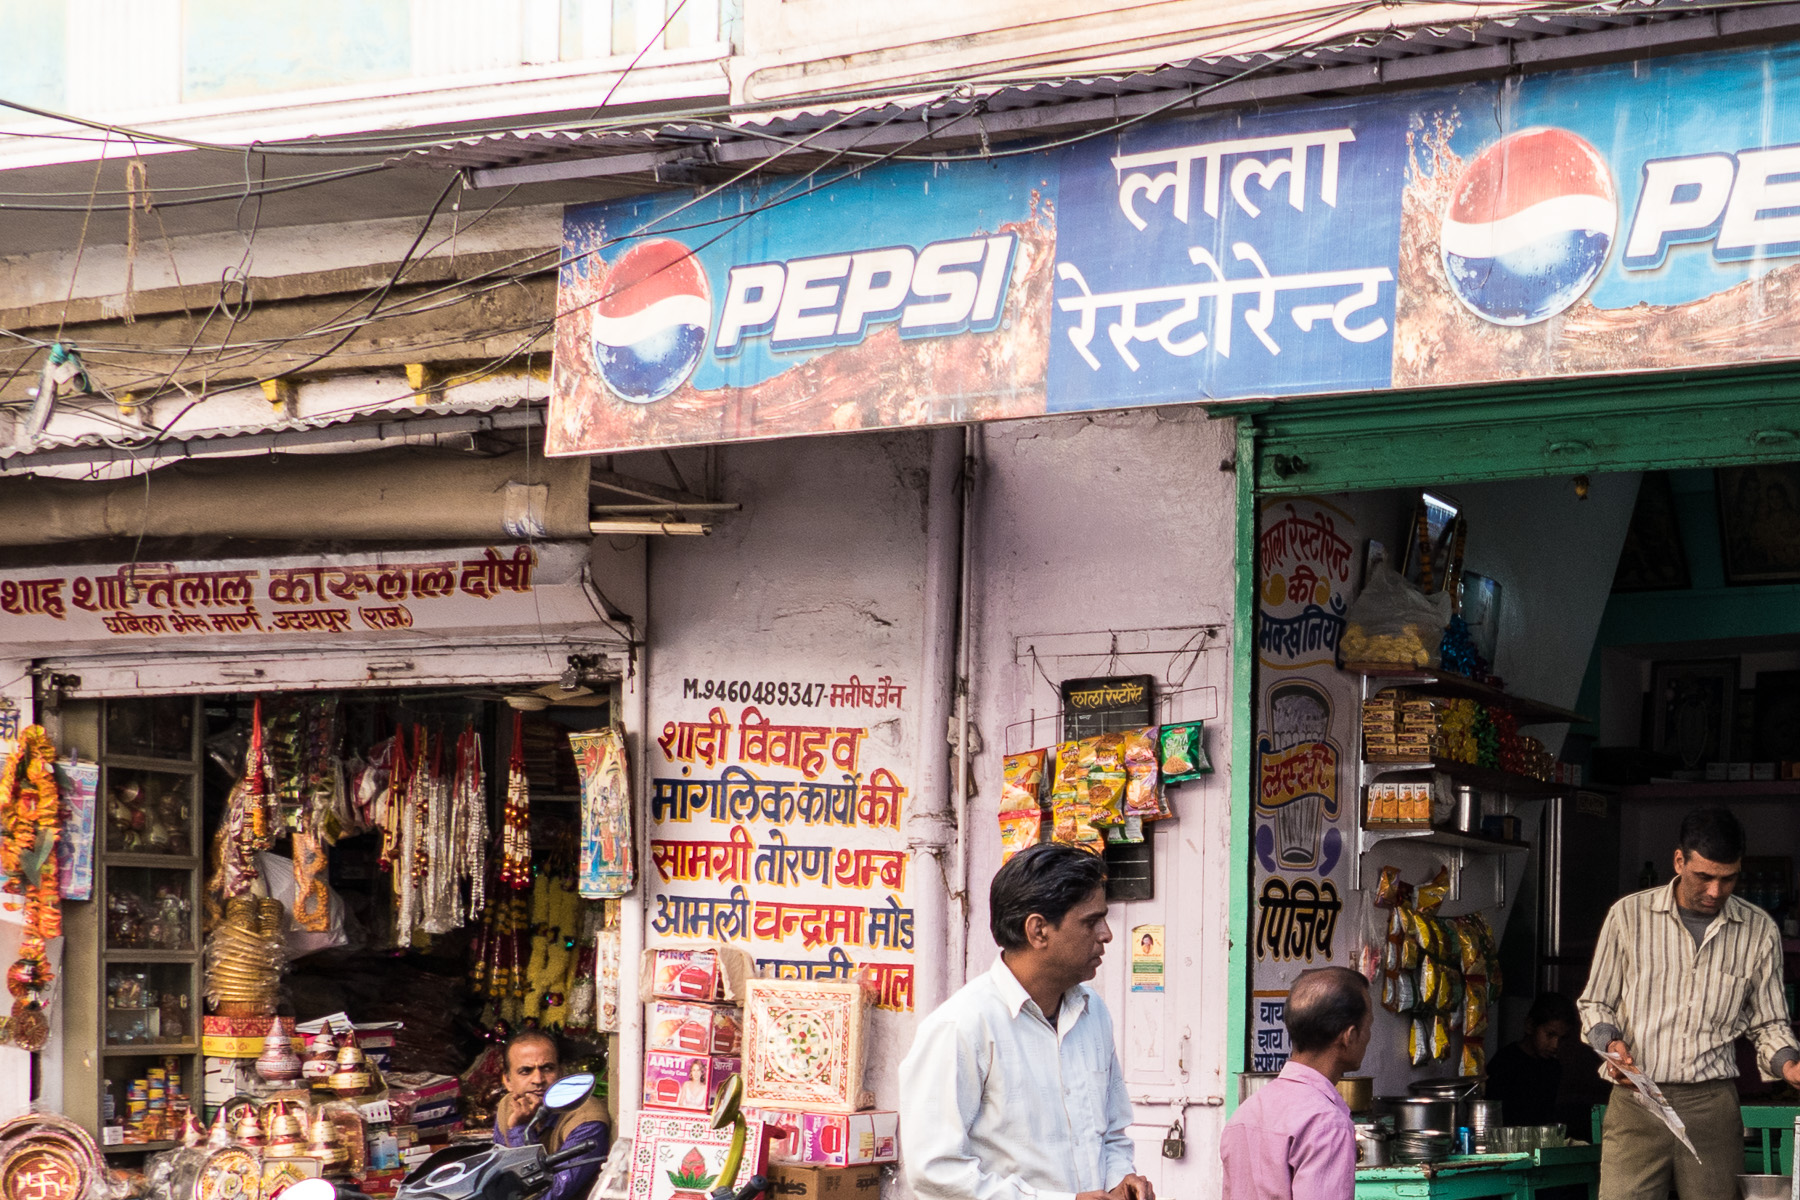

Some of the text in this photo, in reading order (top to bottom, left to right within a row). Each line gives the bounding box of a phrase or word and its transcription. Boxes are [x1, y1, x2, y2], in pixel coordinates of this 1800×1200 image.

[1110, 128, 1354, 231] लाला
[716, 232, 1020, 358] PEPSI
[1057, 242, 1393, 371] रेस्टोरेन्ट
[1261, 519, 1287, 577] लाला
[1, 578, 67, 620] शाह
[460, 544, 538, 600] दोषी
[1288, 565, 1318, 604] की
[208, 606, 263, 633] मार्ग
[1070, 689, 1103, 708] लाला
[657, 706, 868, 778] शादी विवाह व
[652, 766, 798, 824] मांगलिक
[857, 767, 909, 830] की
[651, 825, 755, 885] सामग्री
[755, 829, 835, 889] तोरण
[651, 885, 752, 945] आमली
[753, 901, 867, 950] चन्द्रमा
[1257, 878, 1343, 960] पिजिये
[649, 1055, 686, 1070] AARTI
[1257, 1029, 1283, 1050] चाय
